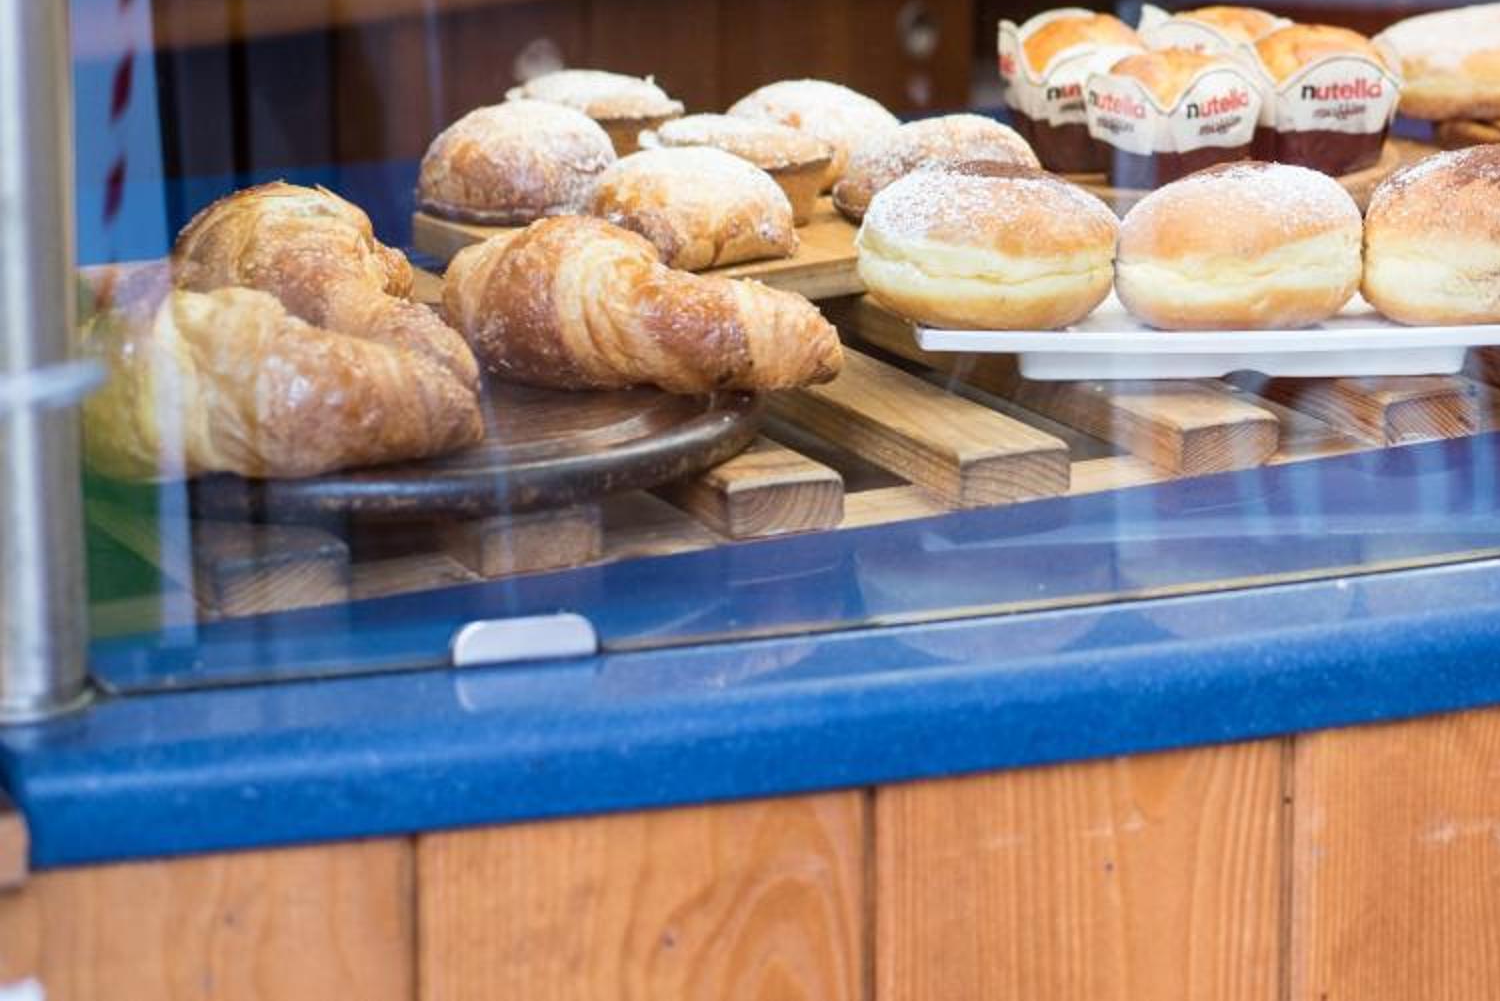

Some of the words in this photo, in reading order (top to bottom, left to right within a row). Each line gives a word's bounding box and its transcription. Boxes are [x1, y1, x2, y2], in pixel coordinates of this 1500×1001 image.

[1187, 88, 1248, 119] nutella
[1302, 78, 1382, 100] nutella
[1089, 90, 1146, 119] nutella
